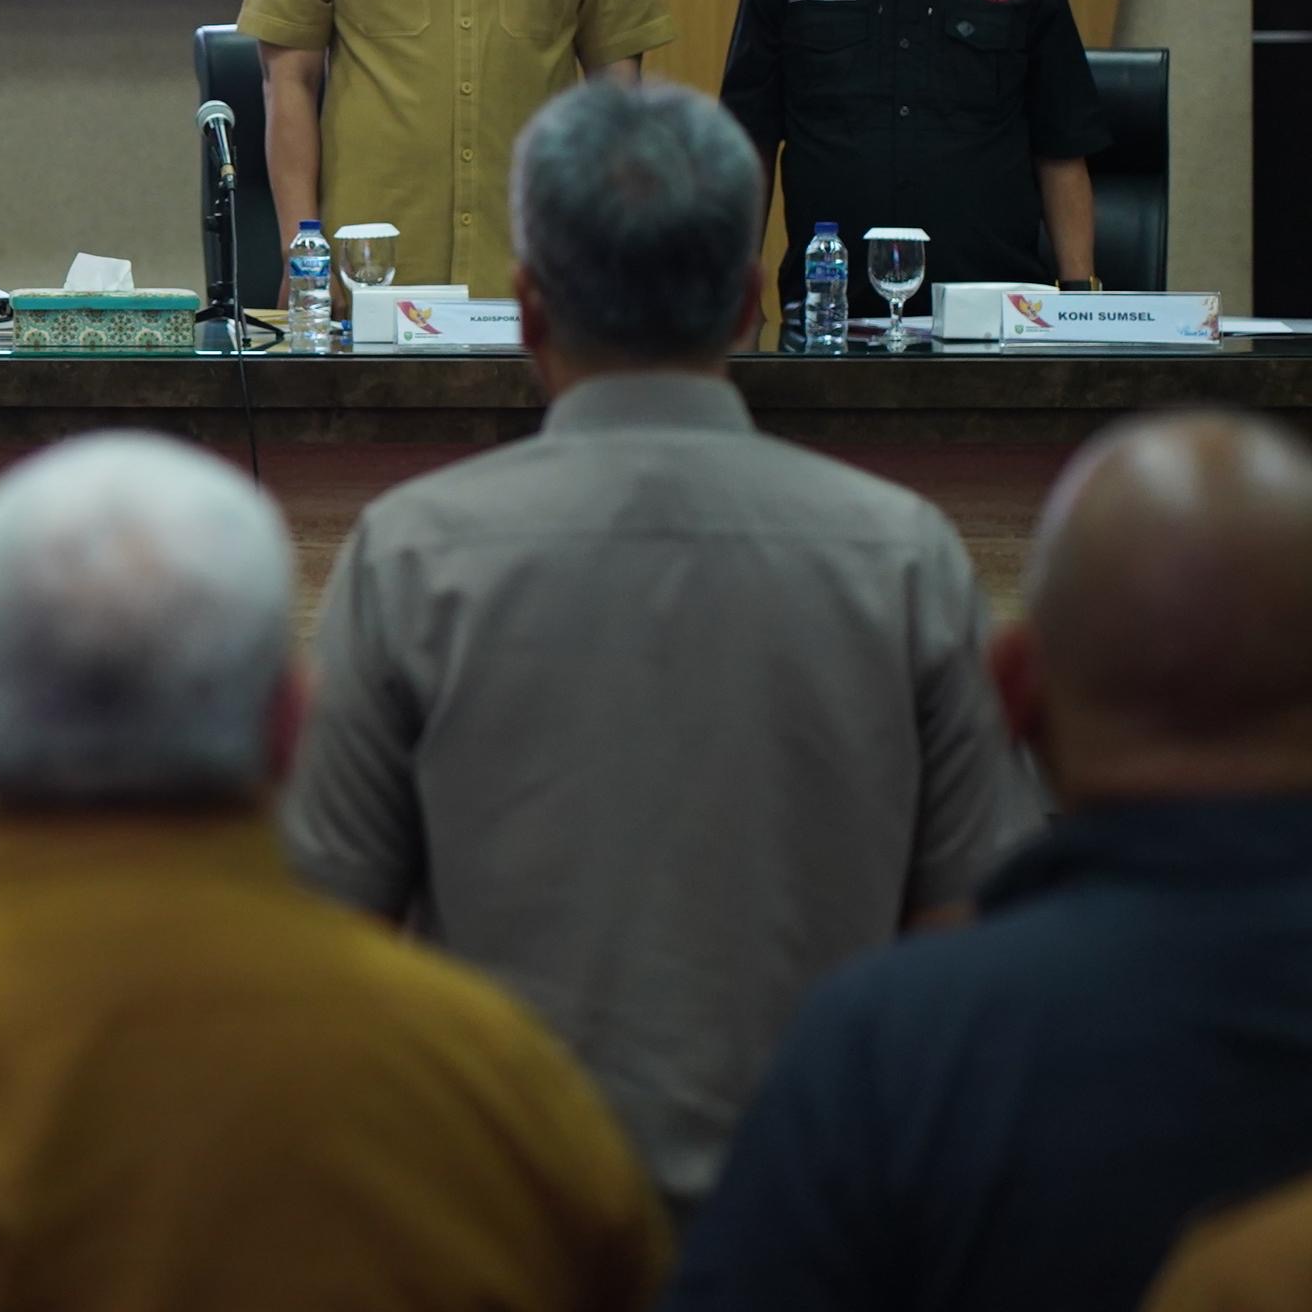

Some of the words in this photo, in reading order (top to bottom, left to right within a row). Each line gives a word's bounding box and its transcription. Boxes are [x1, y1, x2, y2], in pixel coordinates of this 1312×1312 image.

[469, 315, 521, 323] KADISPORA
[1058, 311, 1093, 321] KONI
[1098, 312, 1156, 322] SUMSEL
